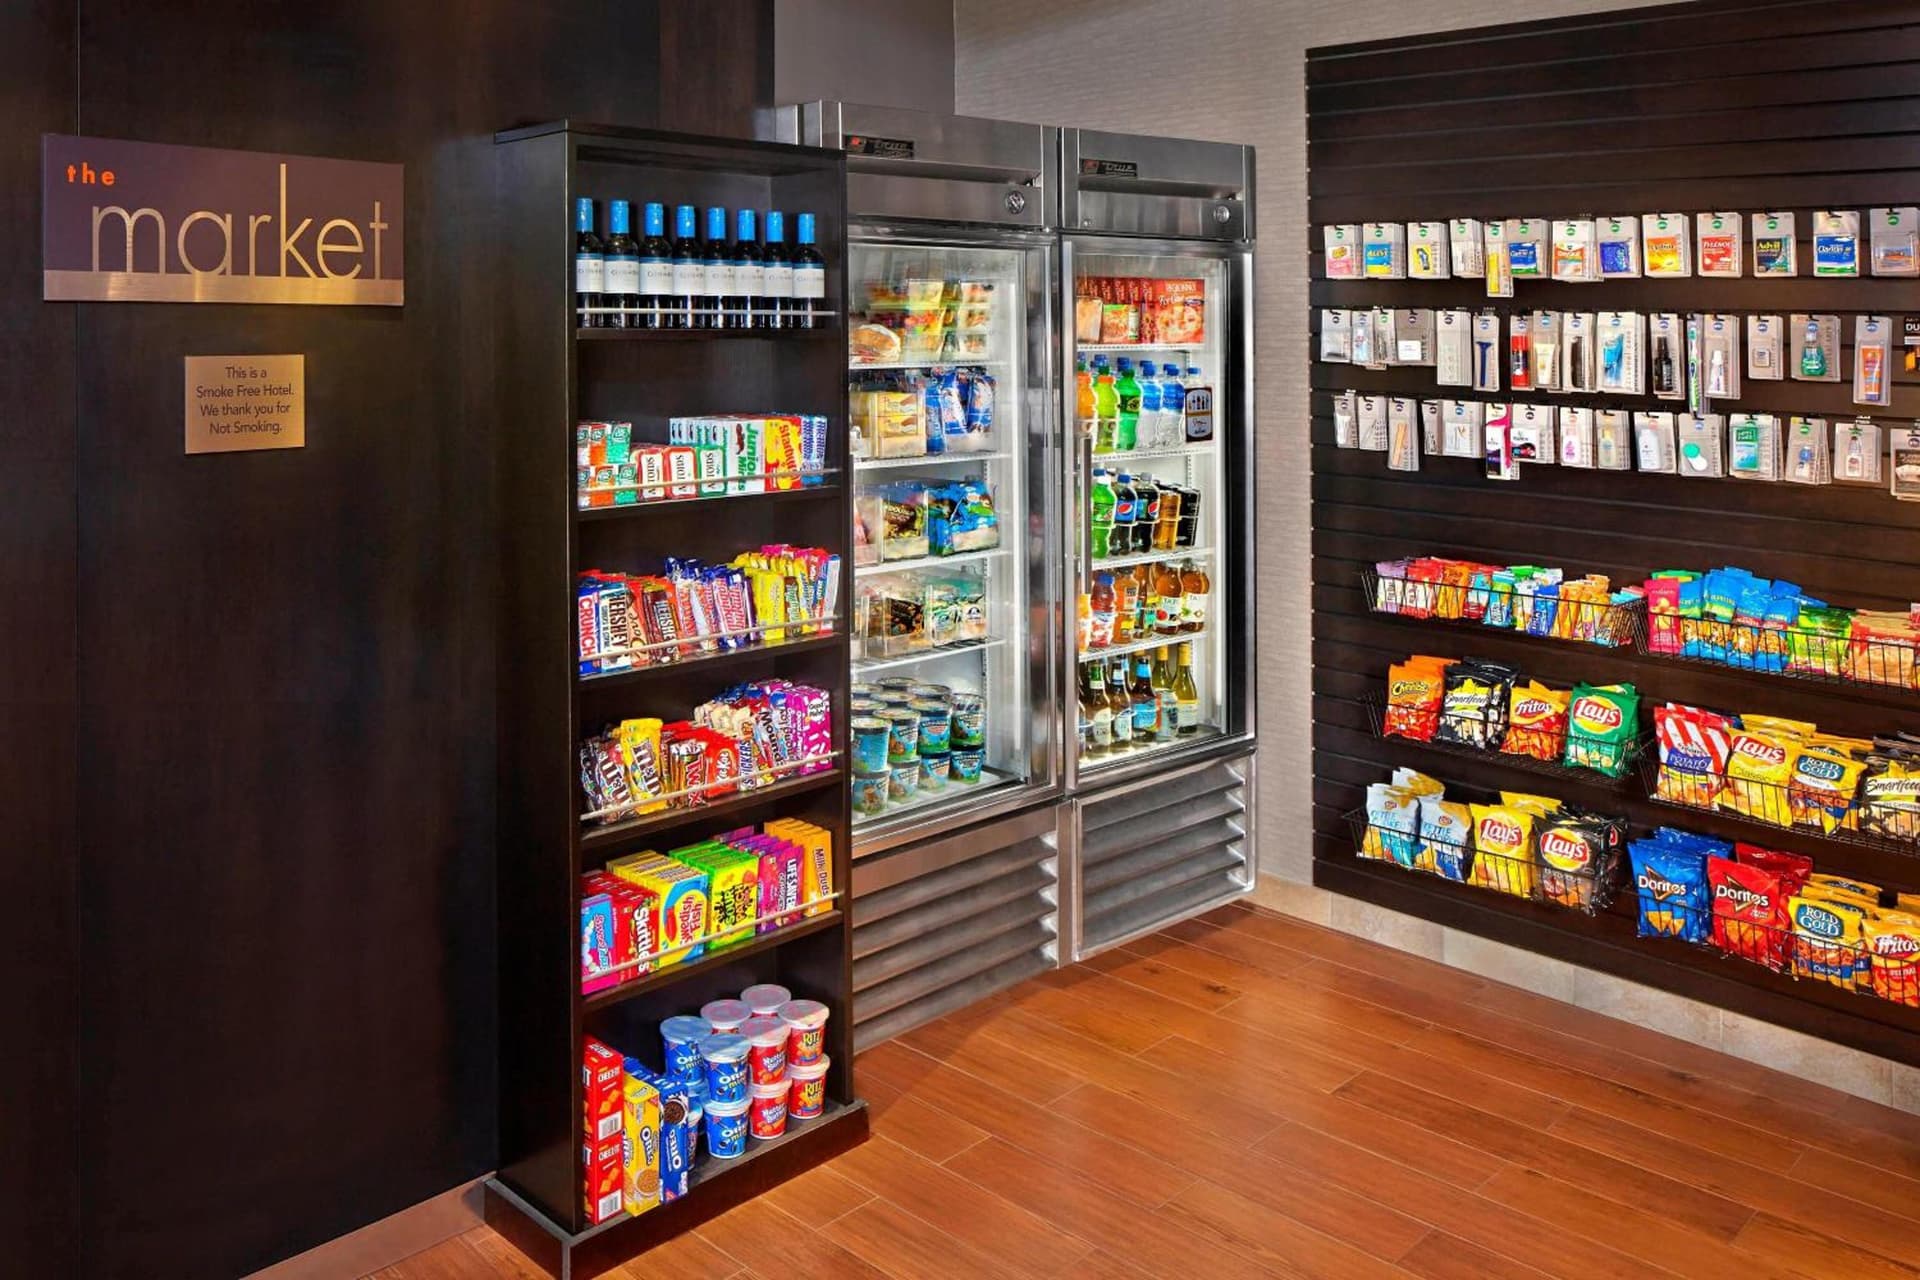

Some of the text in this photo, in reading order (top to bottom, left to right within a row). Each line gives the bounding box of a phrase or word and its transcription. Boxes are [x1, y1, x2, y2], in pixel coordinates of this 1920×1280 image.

[67, 162, 115, 186] the
[92, 163, 389, 281] market
[1757, 240, 1780, 250] Advil
[225, 366, 267, 379] This is a
[196, 383, 295, 399] Smoke Free Hotel.
[200, 401, 291, 418] We thank you for
[209, 420, 282, 434] Not Smoking.
[647, 456, 656, 495] ATOIDS
[676, 454, 685, 492] ATOIDS
[705, 452, 715, 490] ATOIDS
[580, 597, 598, 657] CRUNCH
[687, 757, 703, 808] TWX
[814, 847, 831, 898] Milk Duds
[1638, 875, 1687, 895] Doritos
[1716, 884, 1769, 906] Doritos
[680, 896, 695, 945] Swedish
[690, 902, 703, 934] Fish
[1799, 915, 1840, 936] GOLD
[1805, 905, 1839, 926] ROLD
[803, 1031, 821, 1047] RITZ
[804, 1080, 823, 1097] RITZ
[640, 1126, 655, 1166] OREO
[668, 1129, 682, 1170] OREO
